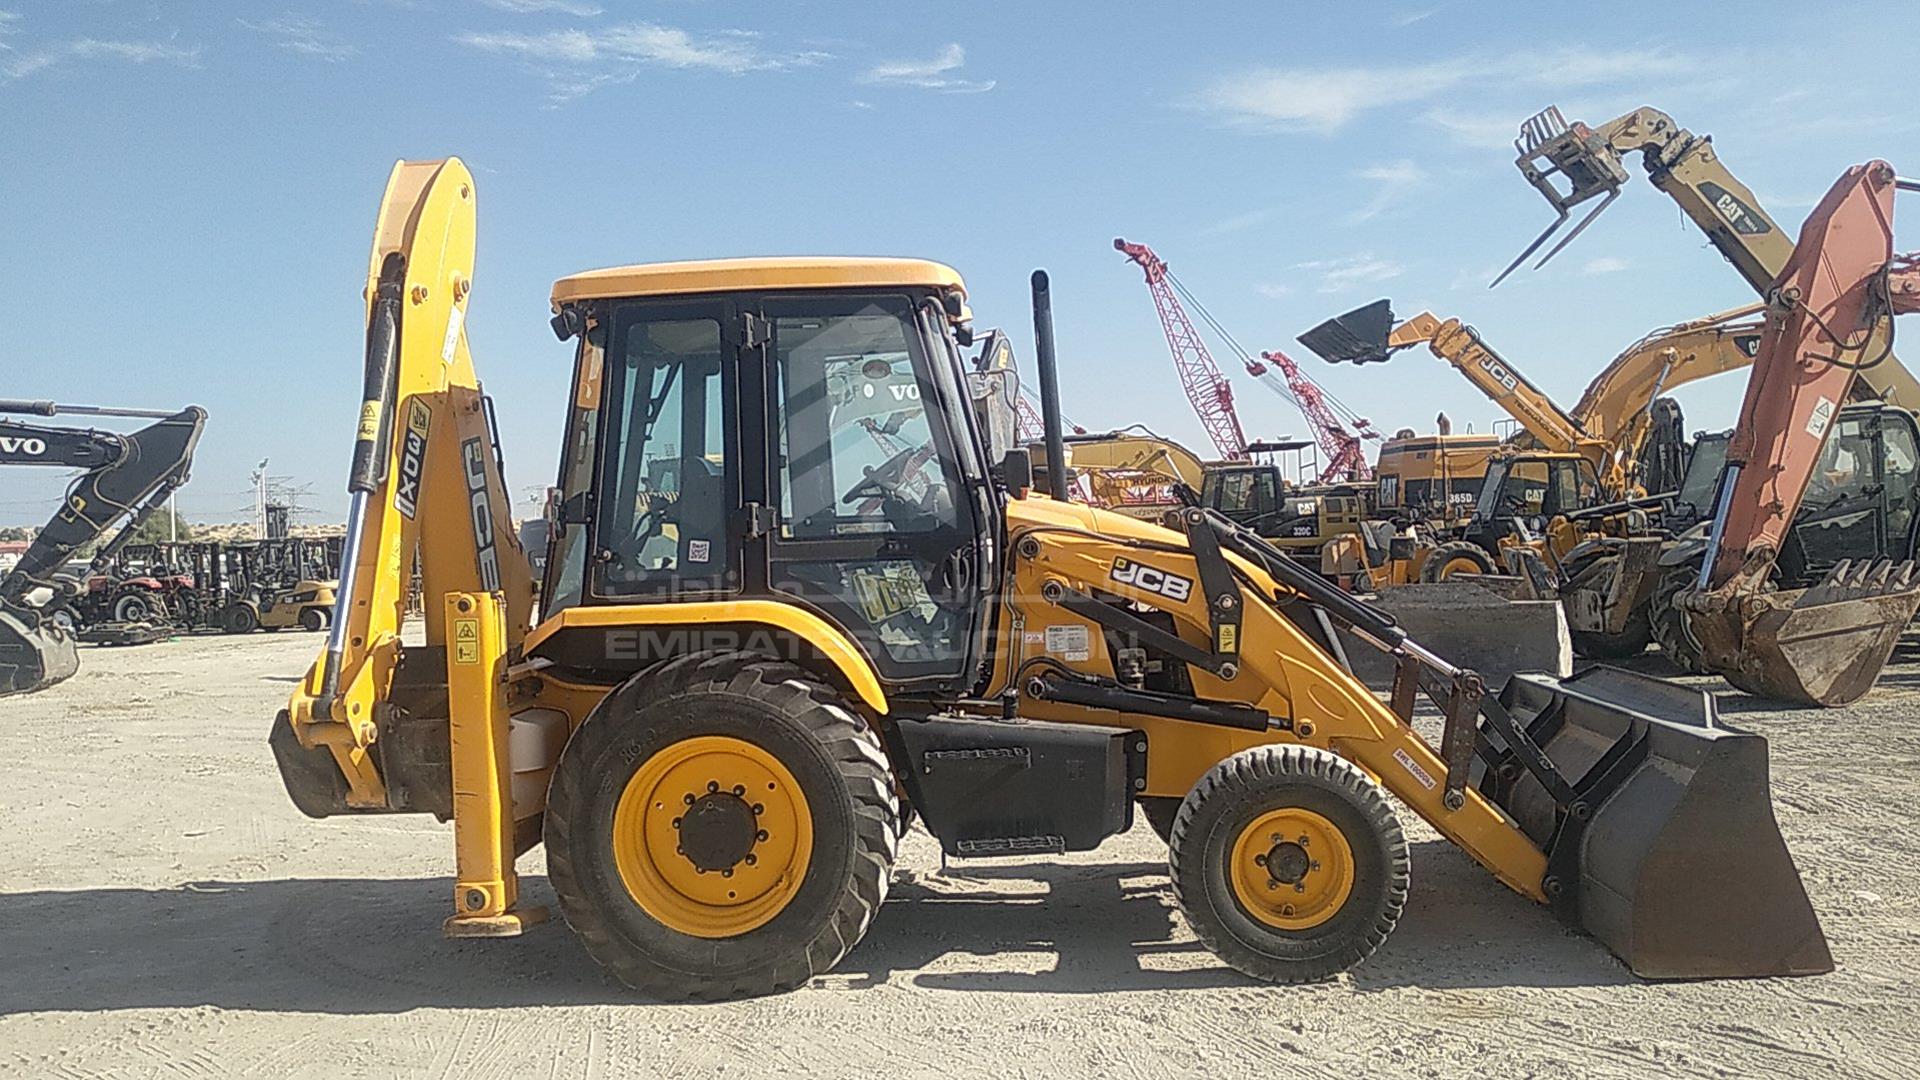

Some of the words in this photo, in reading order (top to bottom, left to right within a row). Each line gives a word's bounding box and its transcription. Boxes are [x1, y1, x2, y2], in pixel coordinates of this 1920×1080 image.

[1716, 193, 1746, 224] CAT
[1481, 356, 1517, 391] JCB
[1133, 475, 1170, 486] HYUNDA
[1526, 489, 1545, 502] CAT
[1297, 502, 1316, 515] CAT
[1112, 558, 1192, 601] JCB
